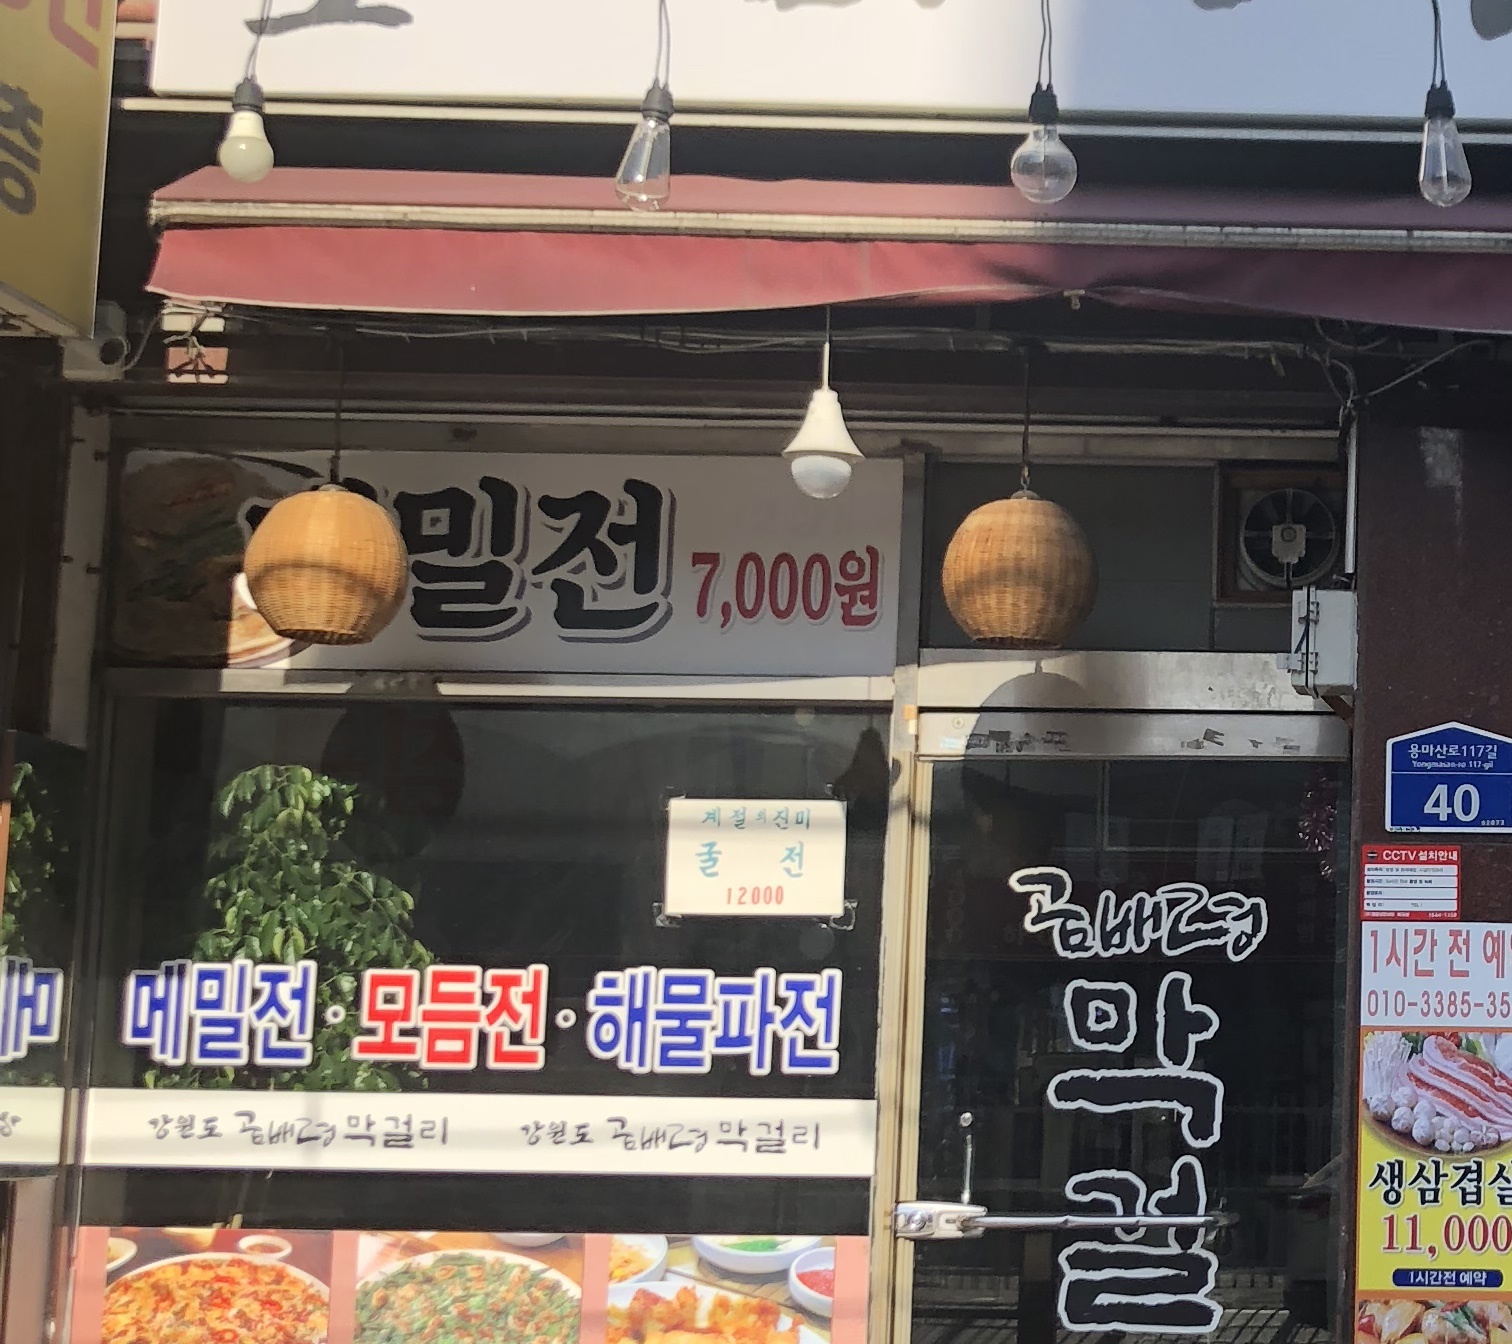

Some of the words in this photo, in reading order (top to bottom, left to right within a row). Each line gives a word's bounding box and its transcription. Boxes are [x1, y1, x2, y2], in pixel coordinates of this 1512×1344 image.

[245, 476, 676, 642] 밀전
[691, 544, 884, 630] 7,000원
[1408, 743, 1498, 760] 용마산로117길
[1423, 783, 1480, 822] 40
[1382, 850, 1417, 862] CCTV
[726, 885, 785, 906] 12000
[124, 959, 317, 1067] 메밀전
[352, 963, 549, 1071] 모듬전
[585, 966, 842, 1074] 해물파전
[1459, 1270, 1487, 1286] 예약
